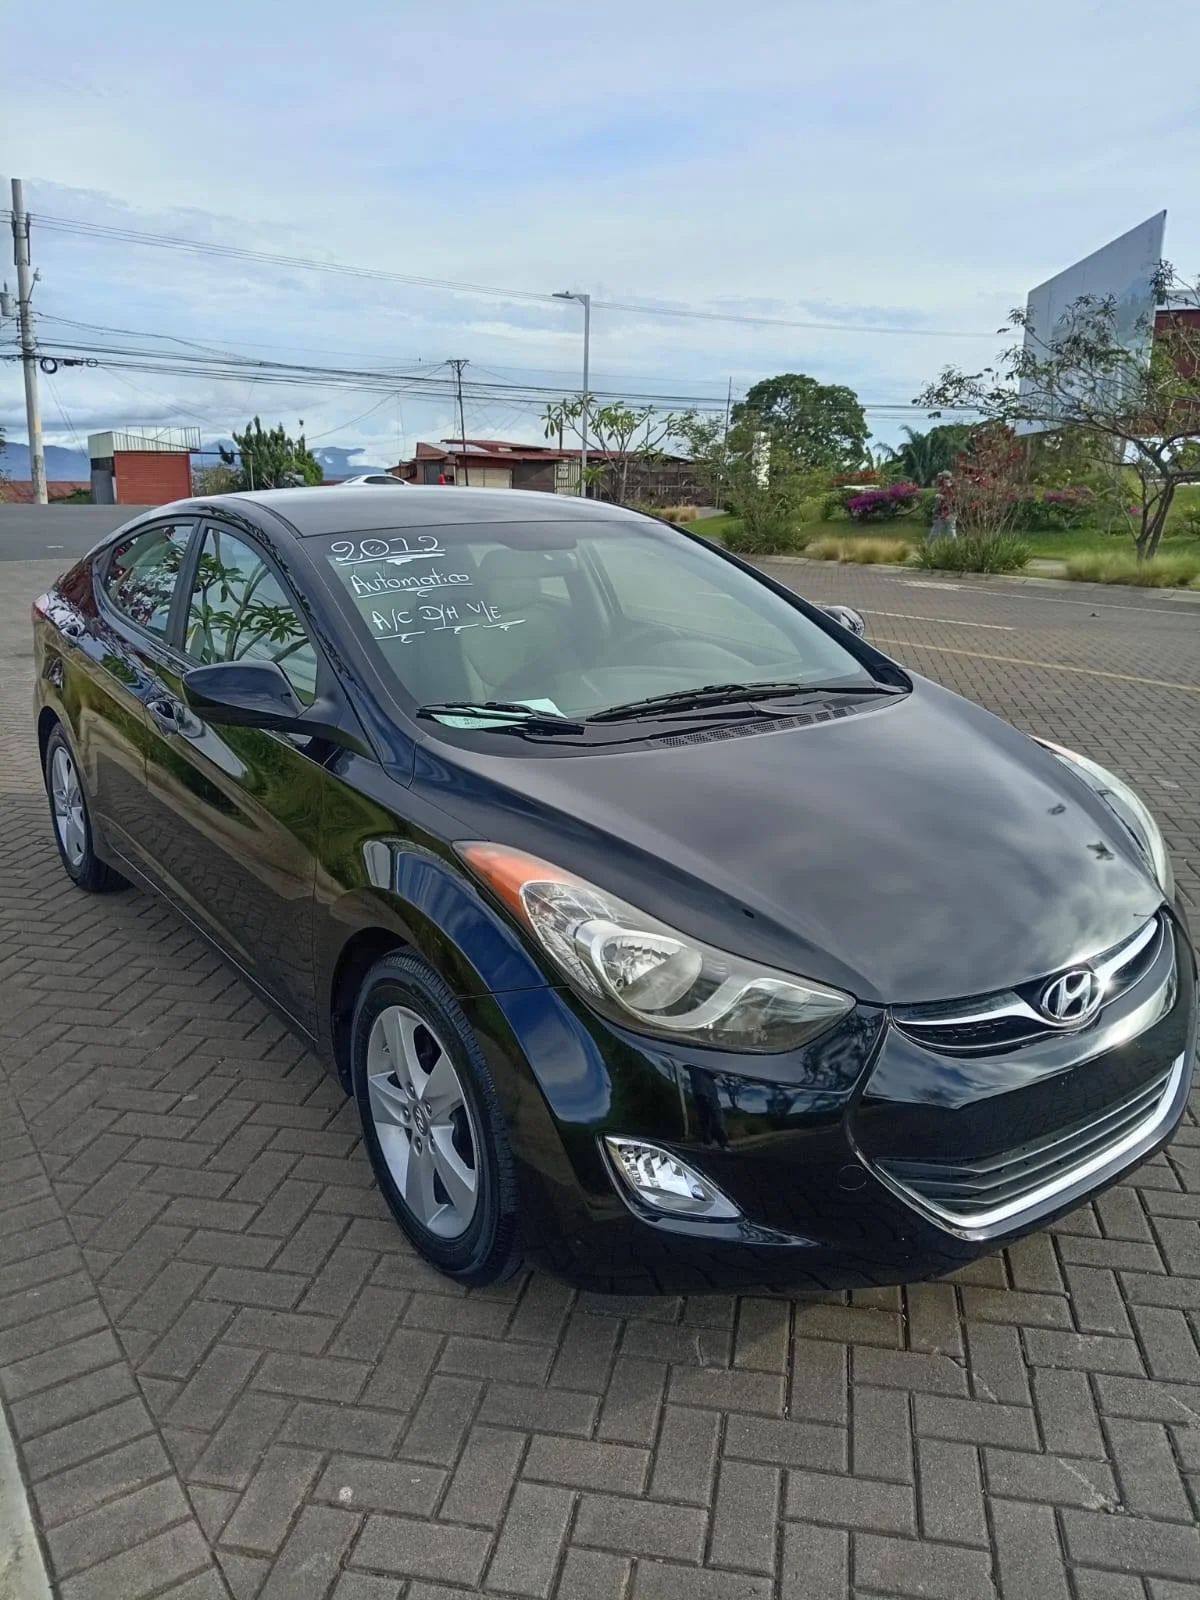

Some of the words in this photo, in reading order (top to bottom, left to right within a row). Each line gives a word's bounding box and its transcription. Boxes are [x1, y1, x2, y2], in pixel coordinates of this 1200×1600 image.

[331, 536, 446, 563] 2012
[350, 567, 471, 595] Automatico
[371, 608, 413, 632] A/C
[418, 603, 460, 628] D/H
[466, 600, 502, 624] V/E
